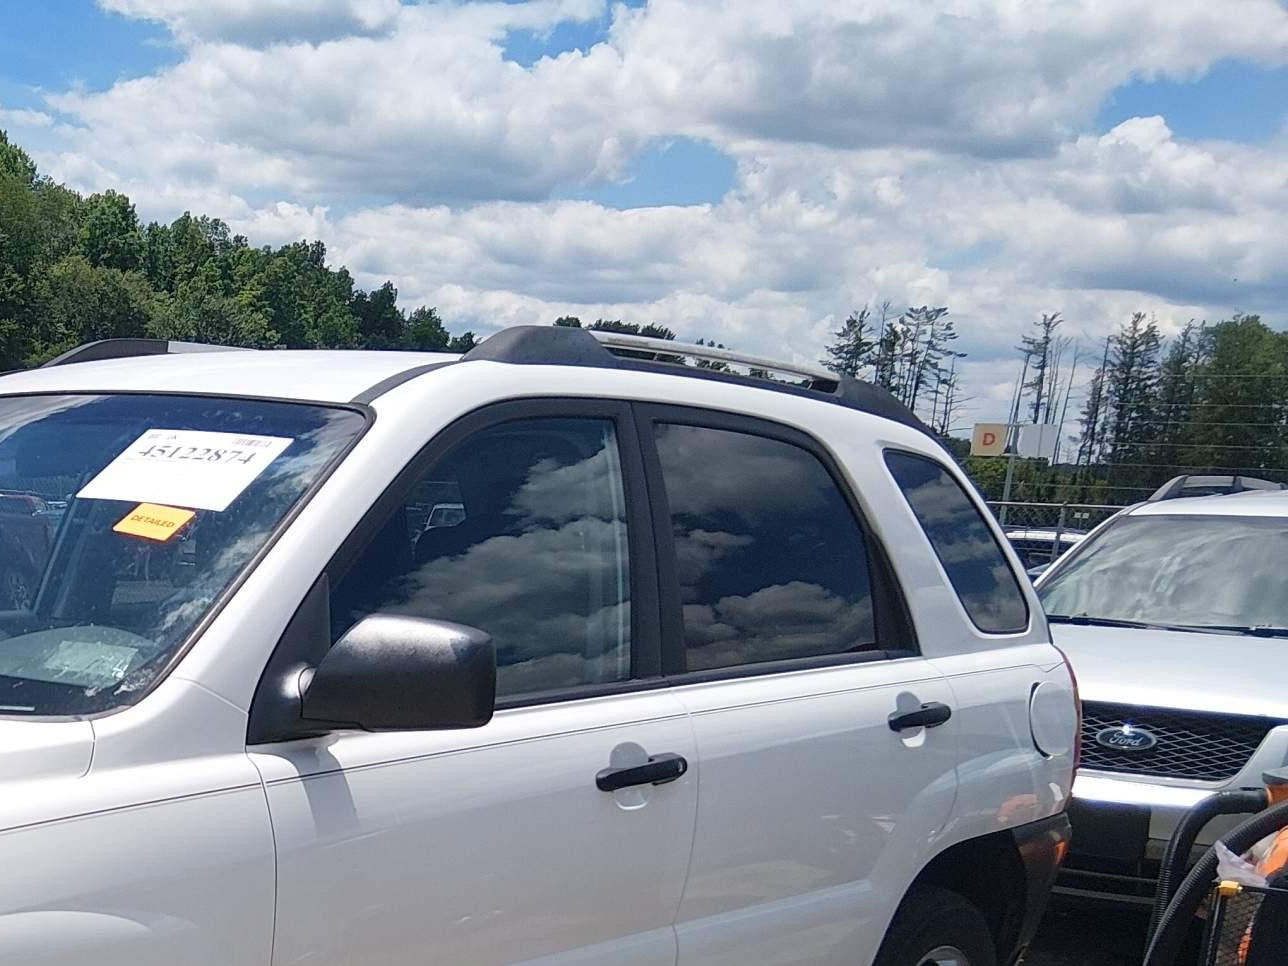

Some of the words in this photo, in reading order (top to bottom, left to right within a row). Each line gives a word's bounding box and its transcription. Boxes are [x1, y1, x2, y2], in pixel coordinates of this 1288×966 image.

[983, 433, 996, 446] D
[138, 445, 257, 465] 45122874
[130, 514, 176, 528] DETAILED
